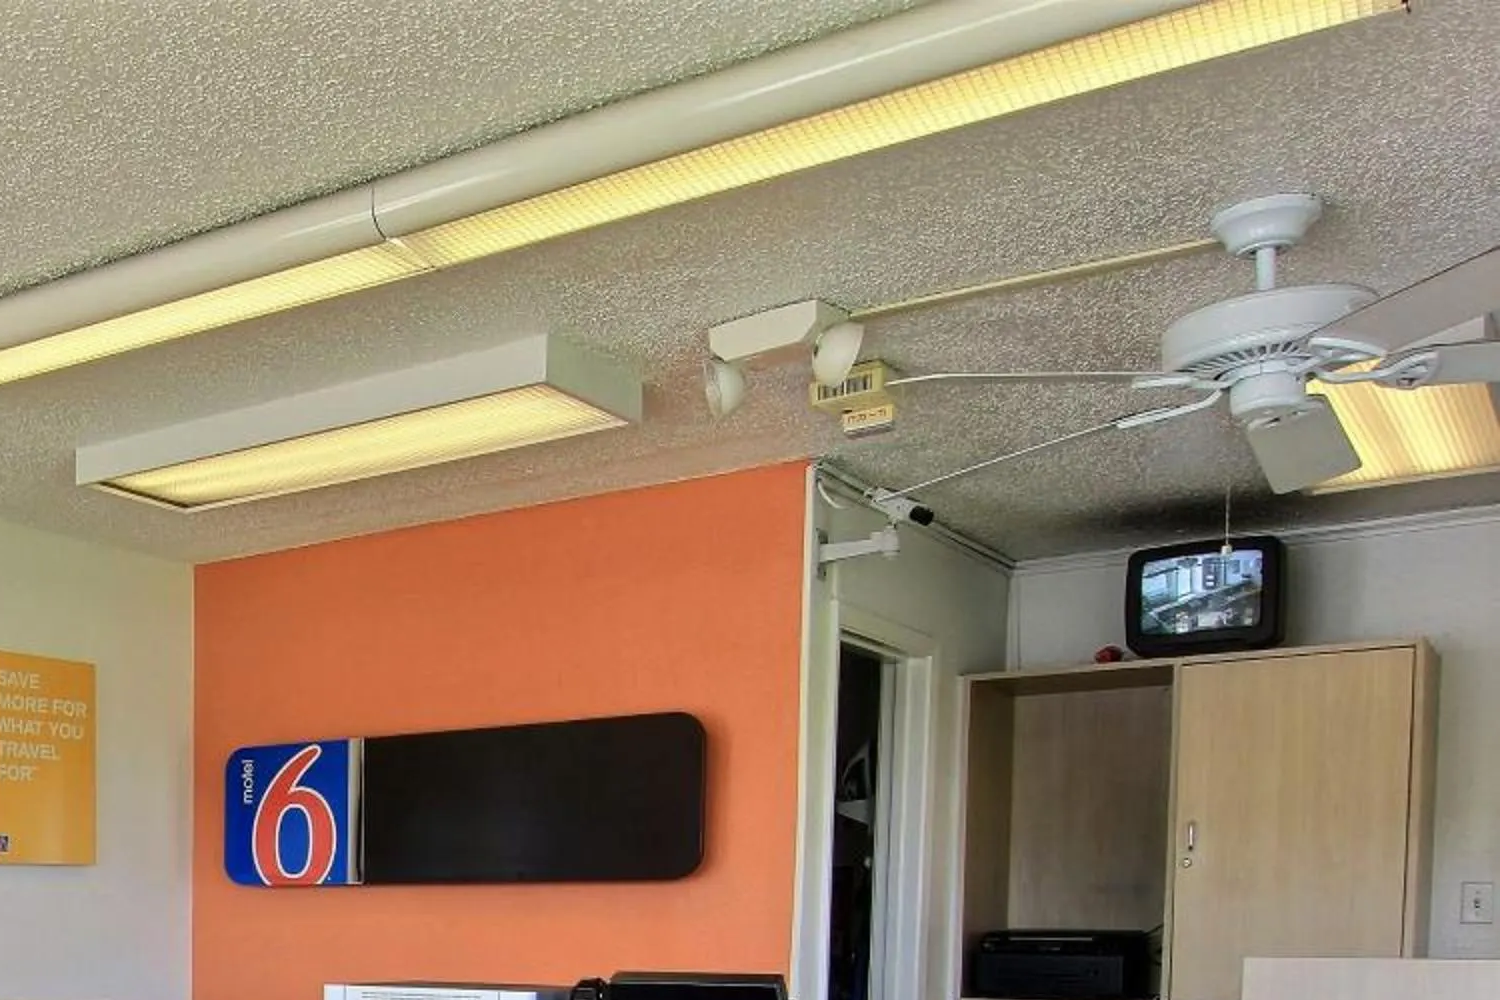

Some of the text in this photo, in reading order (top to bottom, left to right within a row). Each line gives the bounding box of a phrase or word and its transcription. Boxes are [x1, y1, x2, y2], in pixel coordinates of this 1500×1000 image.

[52, 698, 88, 720] FOR
[47, 721, 84, 740] YOU
[241, 759, 255, 805] motel
[252, 743, 337, 888] 6
